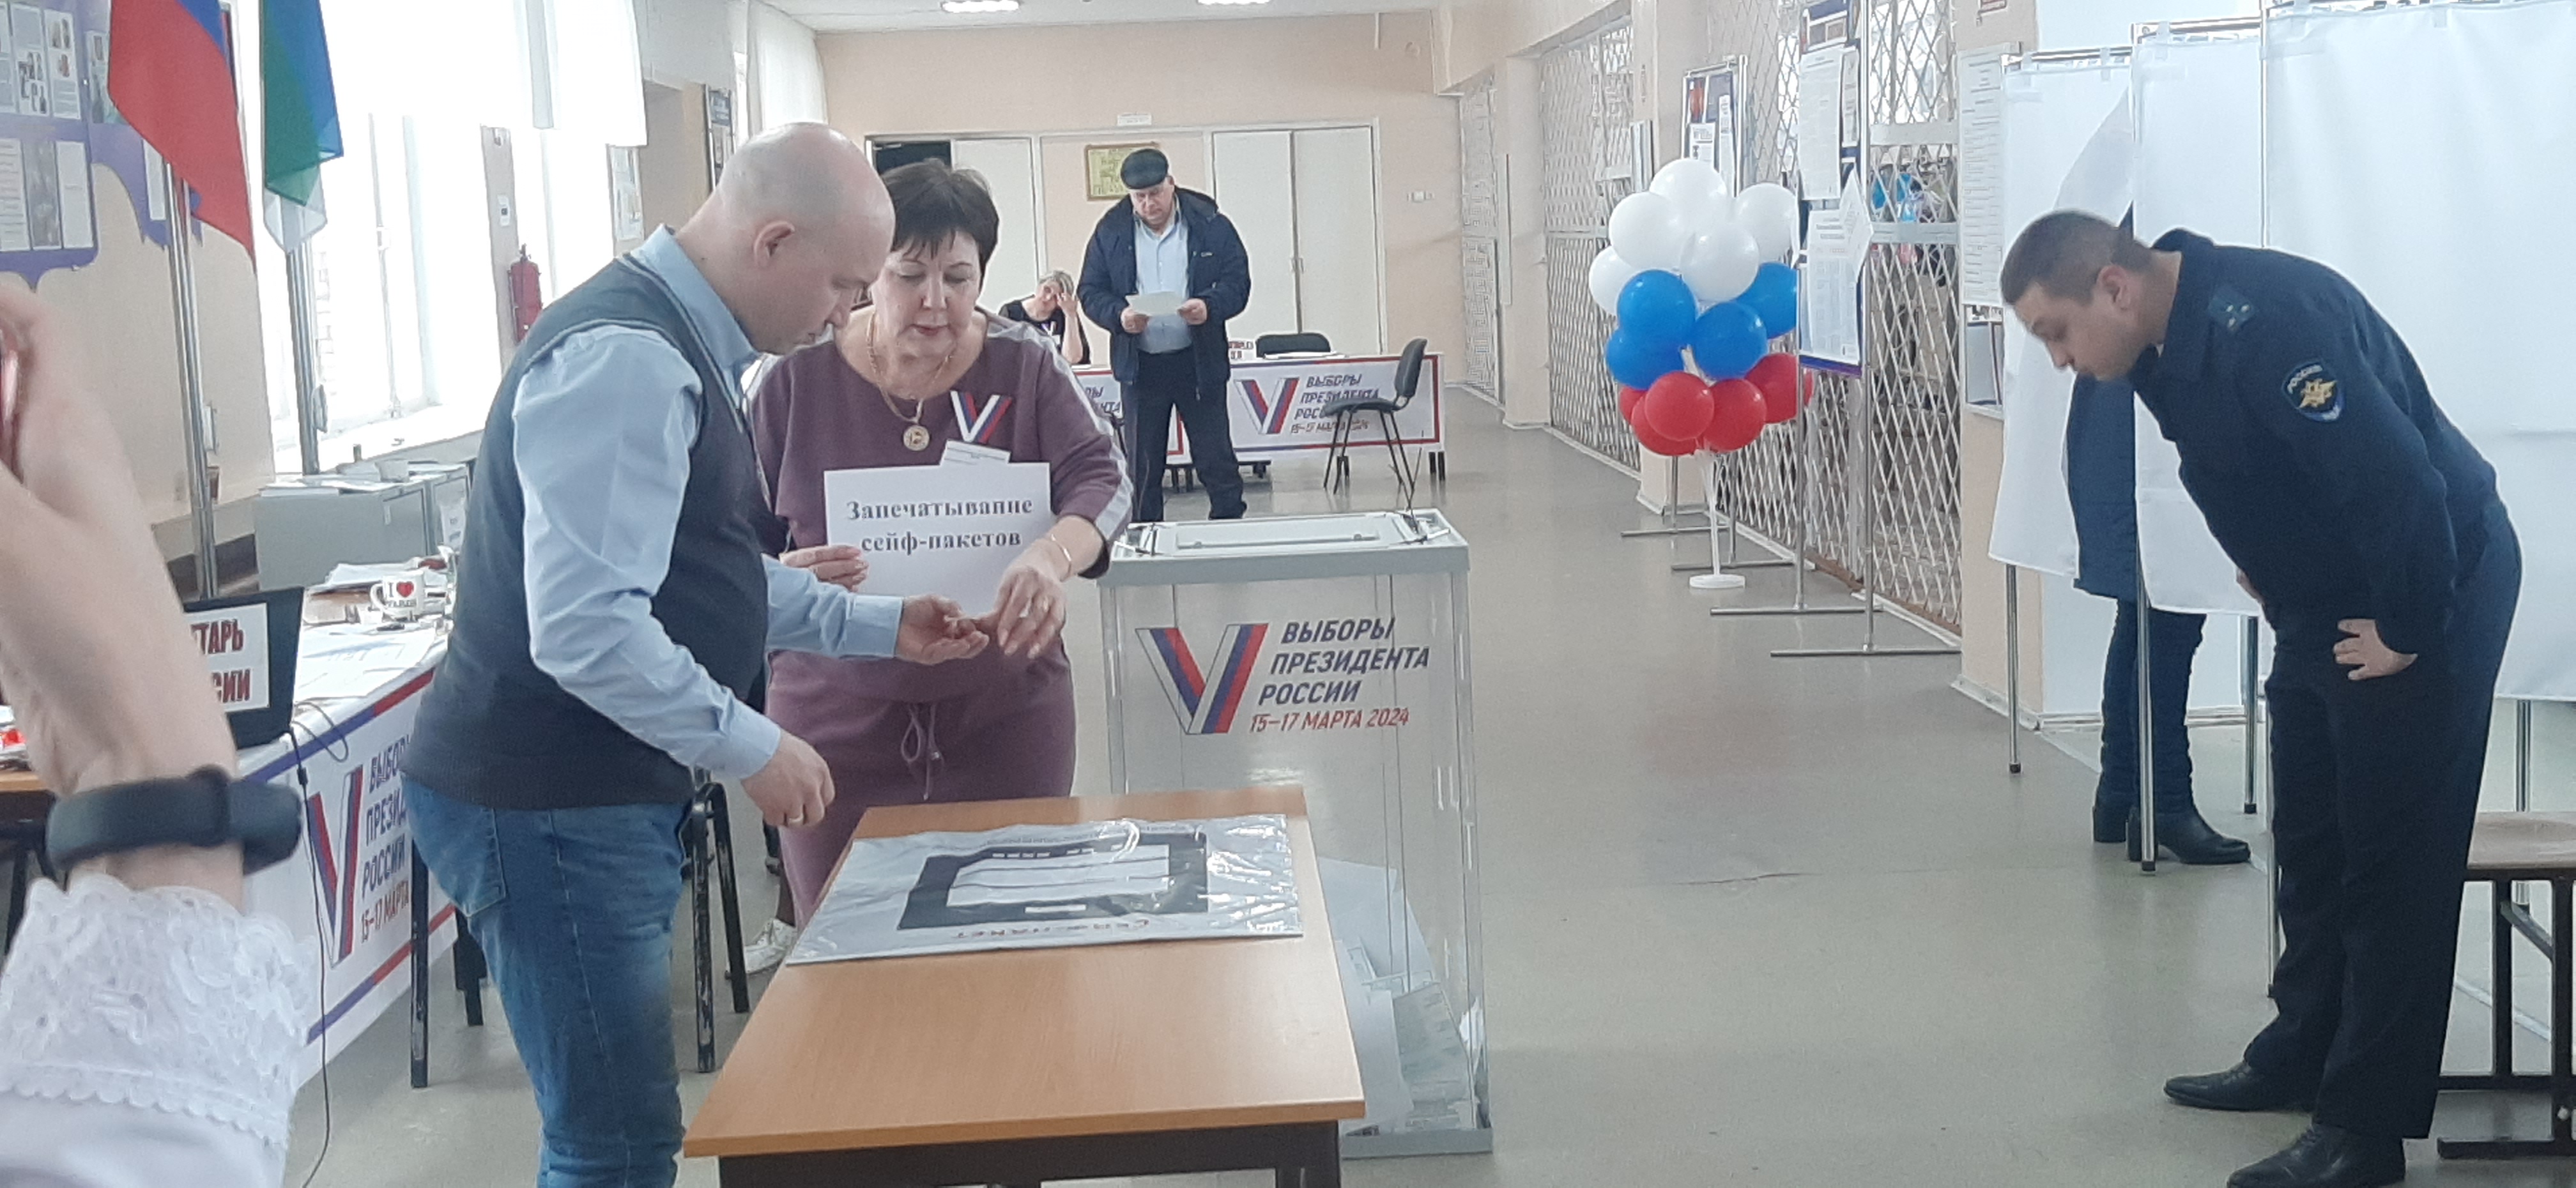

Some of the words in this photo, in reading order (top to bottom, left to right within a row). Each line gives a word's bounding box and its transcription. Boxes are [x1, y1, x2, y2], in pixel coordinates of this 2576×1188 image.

[847, 499, 1033, 520] Запечатывание
[861, 531, 1022, 556] сейф-пакетов
[190, 618, 244, 655] ТАРЬ
[1280, 617, 1395, 644] ВЫБОРЫ
[1270, 646, 1430, 674] ПРЕЗИДЕНТА
[1258, 680, 1363, 705] РОССИИ
[1301, 709, 1363, 730] МАРТА
[1365, 707, 1409, 728] 2024
[362, 833, 406, 901] РОССИИ
